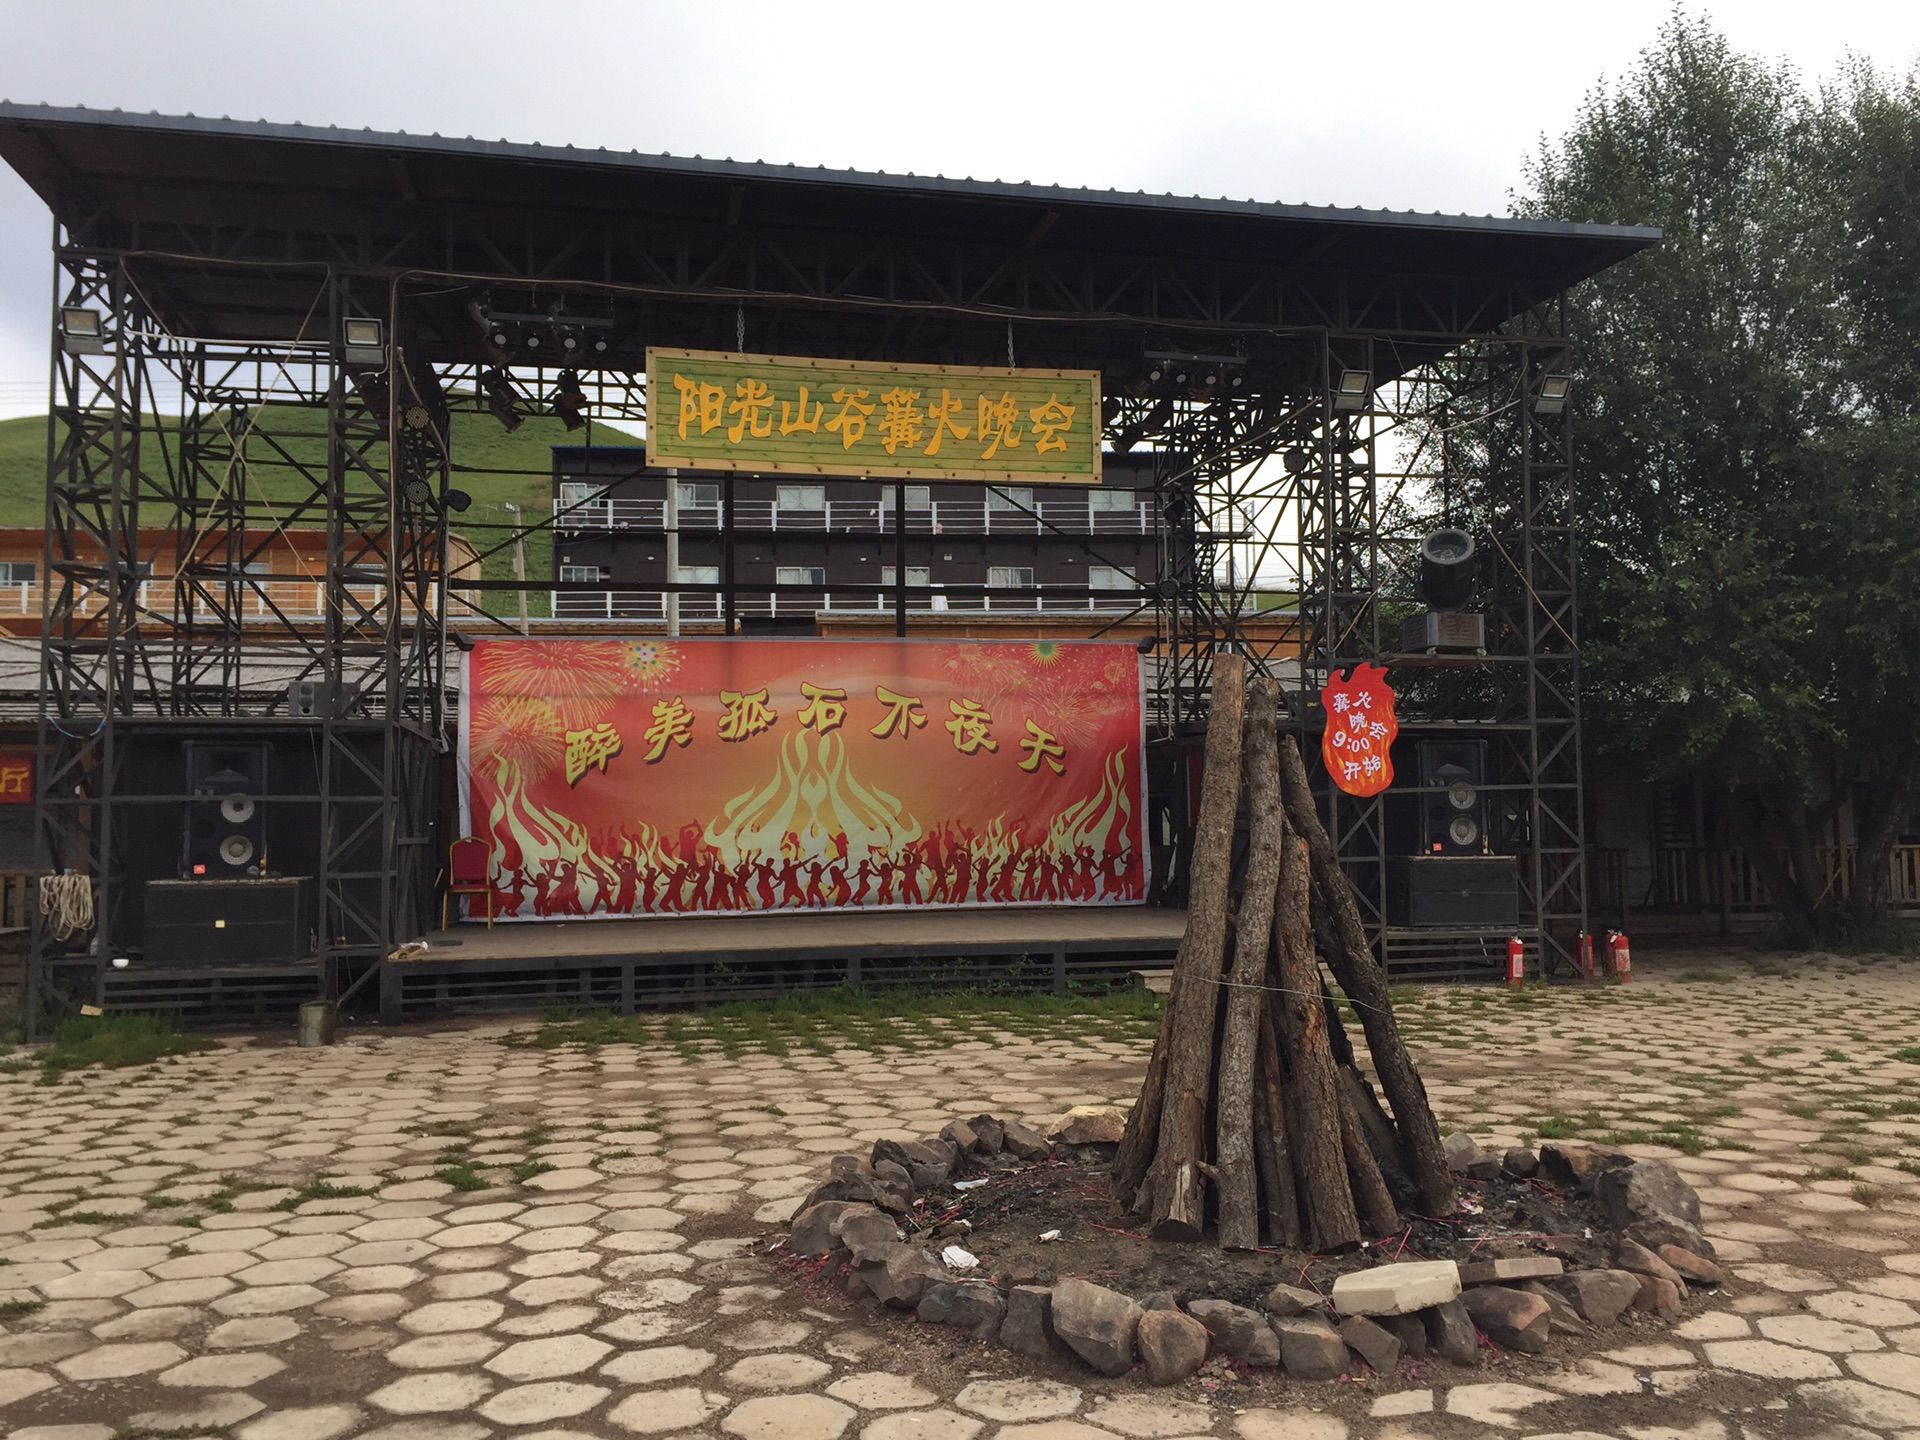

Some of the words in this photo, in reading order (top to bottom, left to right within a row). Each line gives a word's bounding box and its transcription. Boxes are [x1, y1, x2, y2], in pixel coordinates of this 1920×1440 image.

[673, 372, 1076, 460] 阳光山谷篝火晚会
[1332, 691, 1373, 713] 篝火
[564, 681, 1068, 788] 醉美孤石不夜天
[1348, 711, 1389, 740] 晚会
[1332, 731, 1370, 753] 9:00
[1343, 755, 1382, 781] 开始
